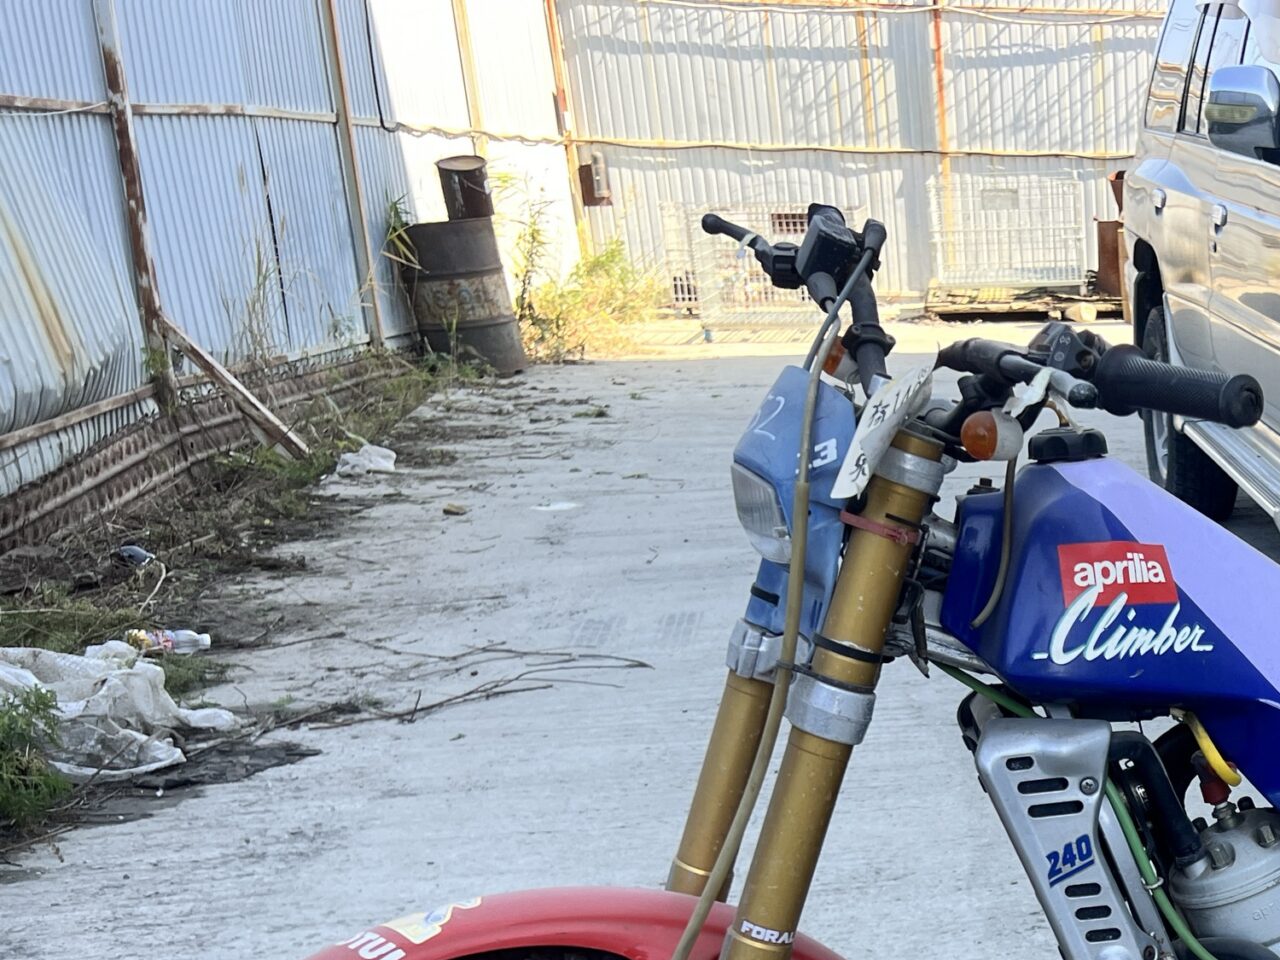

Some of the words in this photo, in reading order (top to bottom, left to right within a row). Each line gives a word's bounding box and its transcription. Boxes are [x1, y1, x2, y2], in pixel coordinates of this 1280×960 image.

[1073, 552, 1166, 593] aprilia
[1049, 582, 1213, 665] Climber
[1045, 833, 1093, 881] 240
